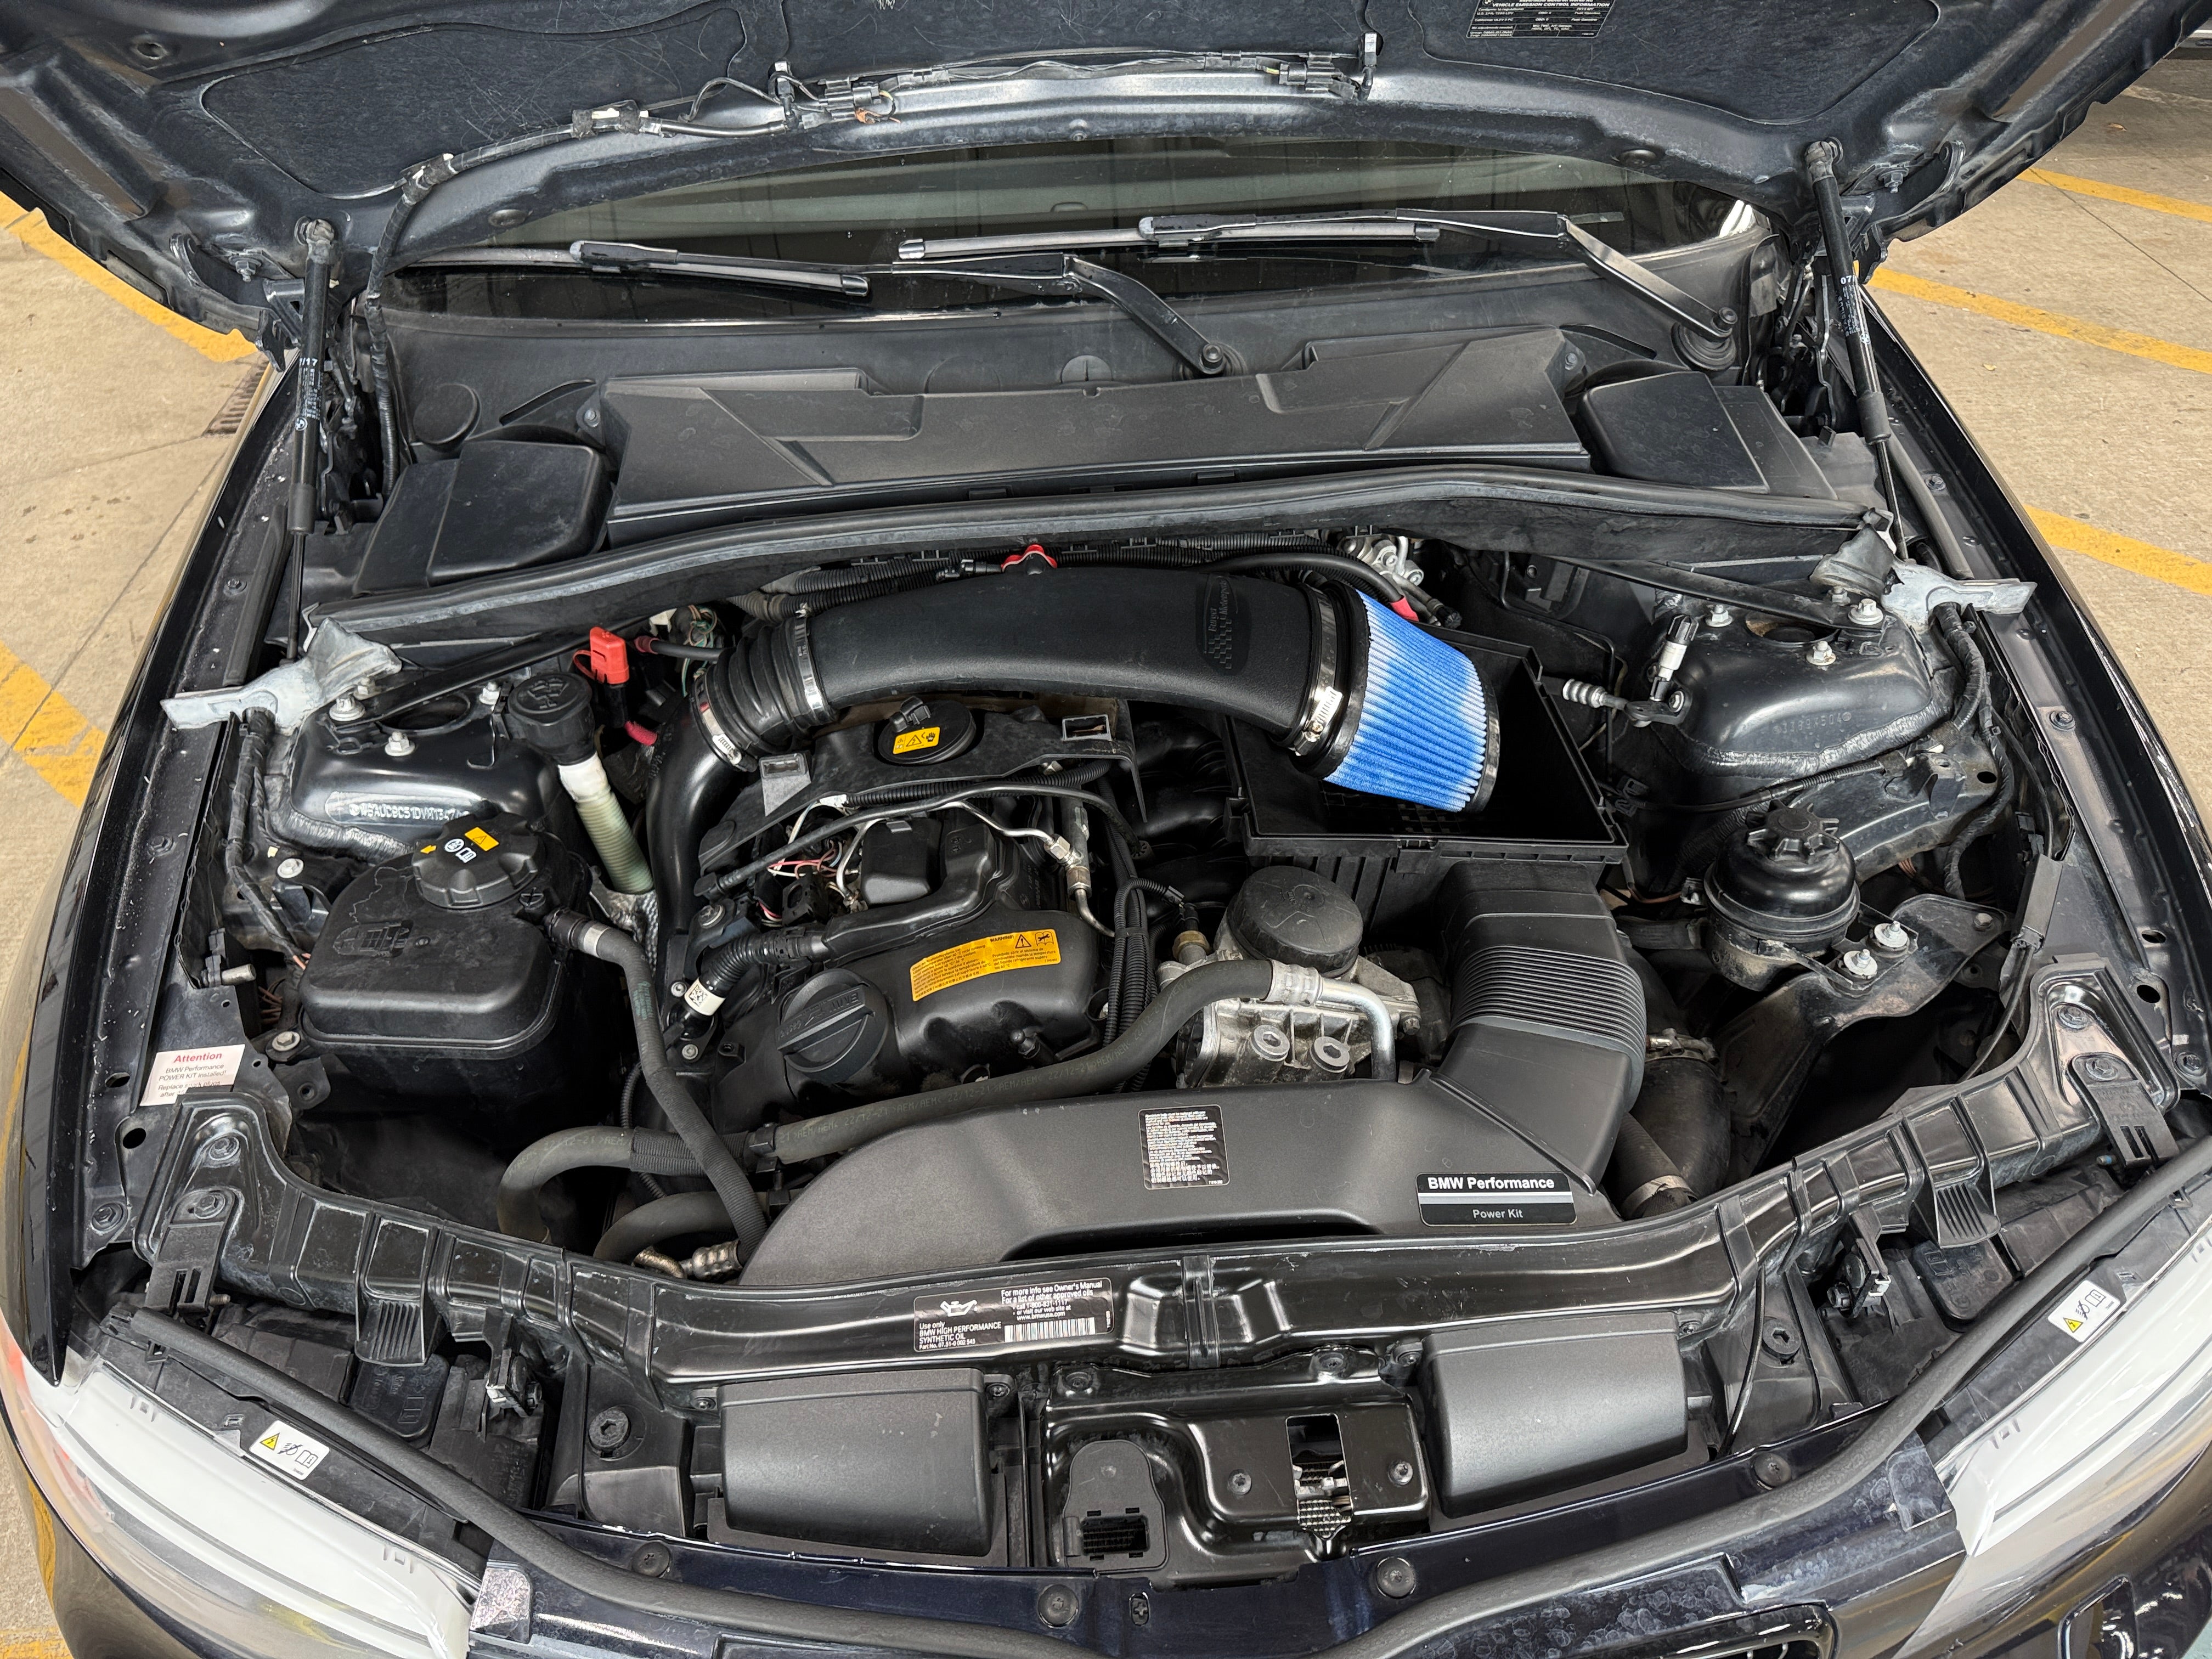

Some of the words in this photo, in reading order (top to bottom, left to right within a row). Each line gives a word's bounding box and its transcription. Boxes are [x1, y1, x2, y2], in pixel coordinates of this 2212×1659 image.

[990, 934, 1014, 943] WARNING!
[173, 1052, 223, 1063] Attention
[184, 1064, 224, 1073] Performance
[159, 1073, 185, 1081] POWER
[1427, 1177, 1464, 1189] BMW
[1466, 1177, 1555, 1190] Performance
[1472, 1209, 1505, 1218] Power
[1507, 1208, 1523, 1218] Kit
[1001, 1289, 1012, 1297] For
[1053, 1283, 1080, 1292] Owner's
[1080, 1280, 1103, 1290] Manual
[1001, 1296, 1013, 1305] For
[1018, 1295, 1027, 1303] list
[1035, 1292, 1052, 1301] other
[1053, 1289, 1082, 1300] approved
[1082, 1288, 1093, 1296] oils
[1016, 1302, 1025, 1311] call
[919, 1329, 936, 1337] BMW
[936, 1326, 952, 1335] HIGH
[953, 1321, 1002, 1334] PERFORMANCE
[932, 1321, 946, 1329] only
[919, 1333, 955, 1345] SYNTHETIC
[955, 1332, 966, 1340] OIL
